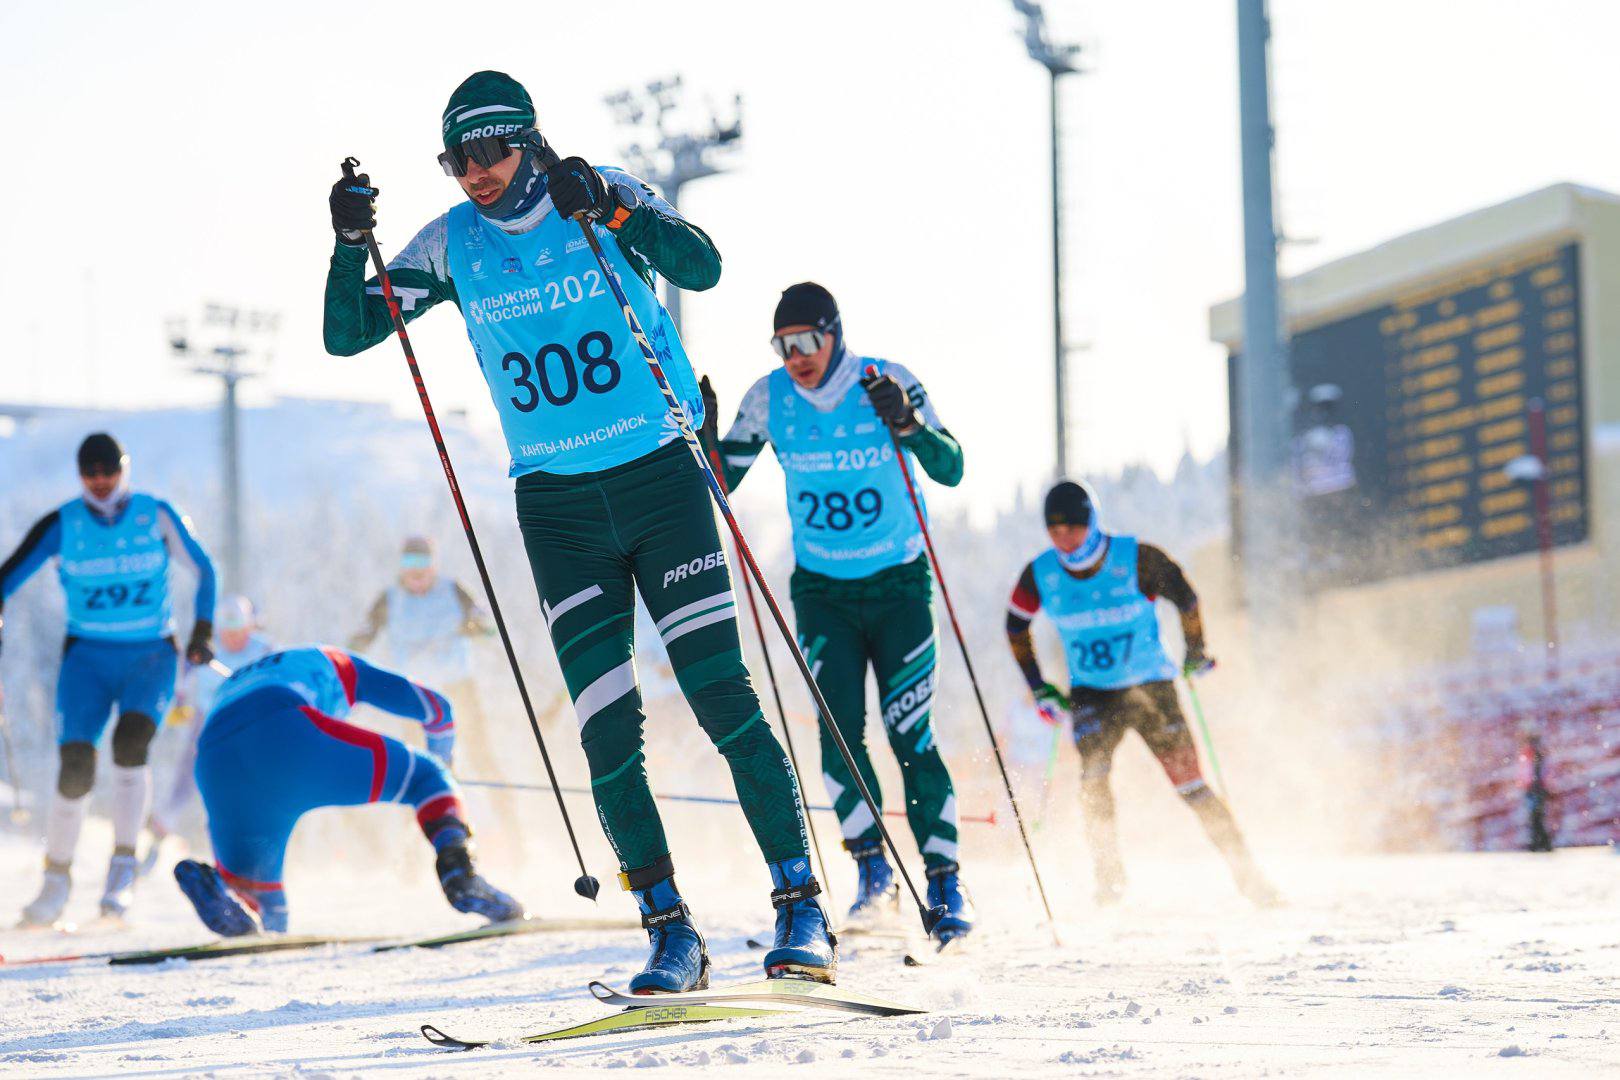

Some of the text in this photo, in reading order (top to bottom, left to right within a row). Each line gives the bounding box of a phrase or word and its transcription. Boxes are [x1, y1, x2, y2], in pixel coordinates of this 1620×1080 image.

[501, 330, 621, 413] 308
[519, 413, 648, 458] ХАНТЫ-МАНСИЙСК
[835, 441, 893, 471] 2026
[799, 487, 883, 531] 289
[1071, 631, 1136, 673] 287
[648, 909, 681, 924] SPINE
[645, 1007, 688, 1022] FISCHER
